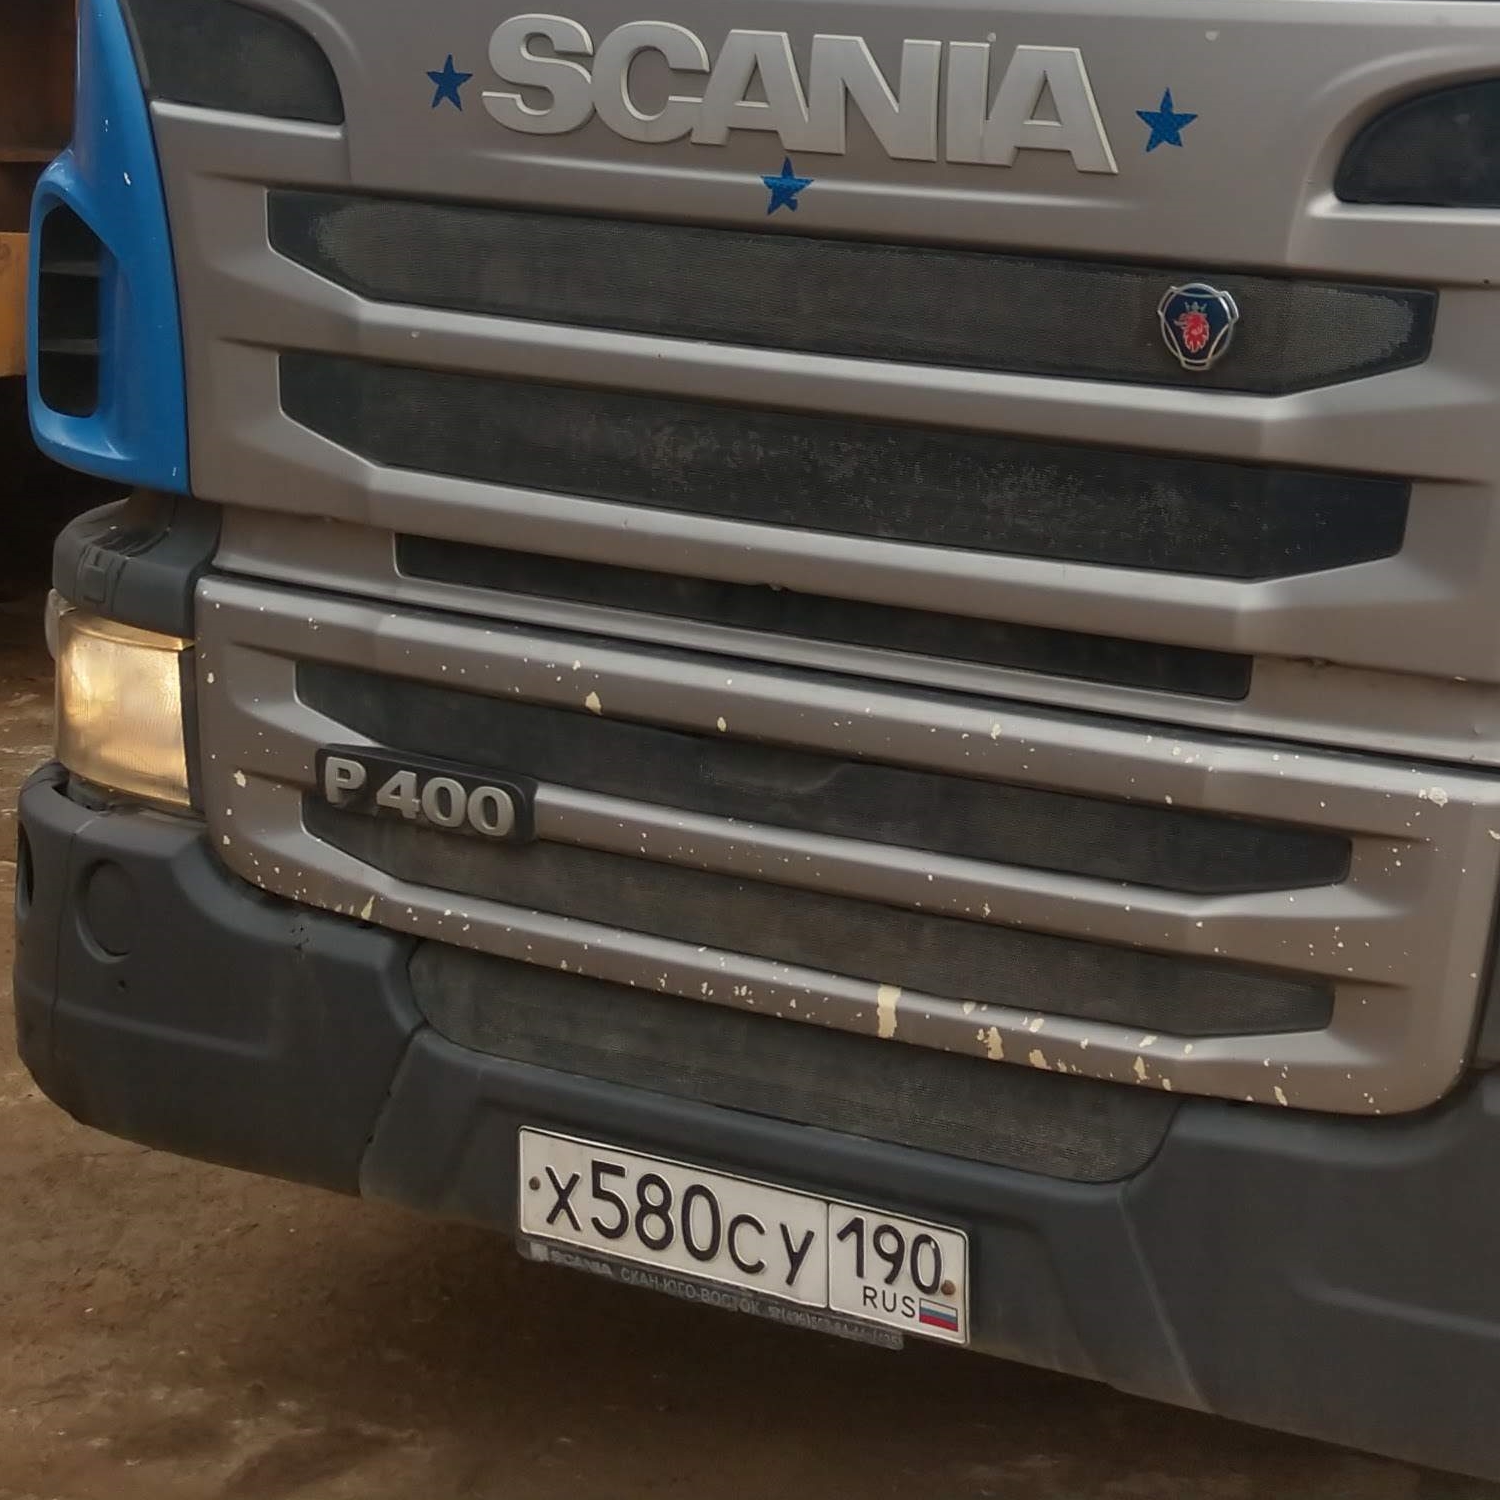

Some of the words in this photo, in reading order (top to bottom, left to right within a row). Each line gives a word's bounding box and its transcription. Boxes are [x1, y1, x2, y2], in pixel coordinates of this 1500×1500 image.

[481, 11, 1120, 176] SCANIA
[324, 755, 367, 805] P
[375, 769, 516, 838] 400
[836, 1216, 943, 1296] 190
[862, 1285, 916, 1319] RUS
